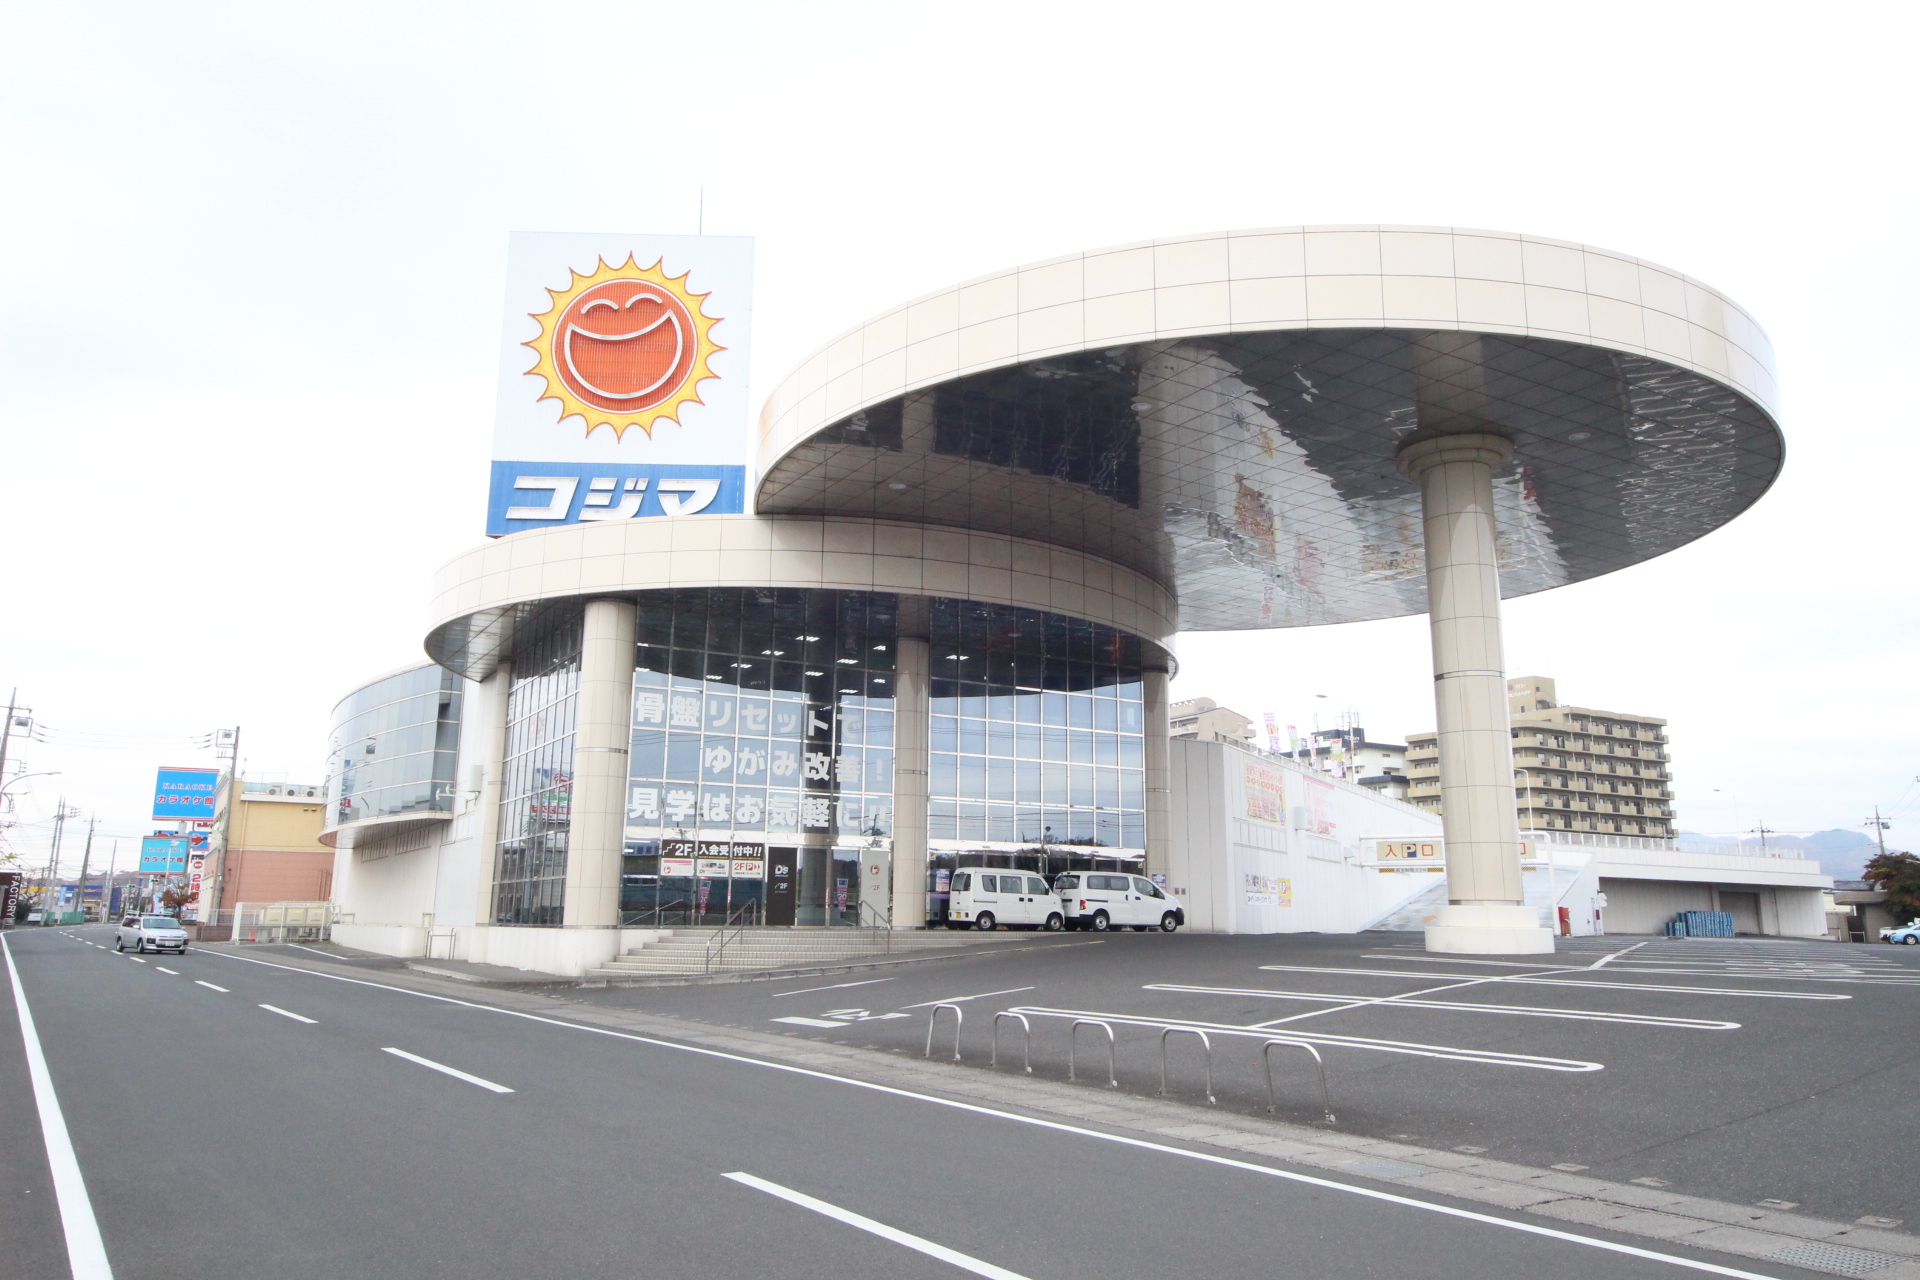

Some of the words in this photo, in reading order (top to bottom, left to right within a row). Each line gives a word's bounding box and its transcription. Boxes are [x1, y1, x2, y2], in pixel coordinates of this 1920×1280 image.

[505, 475, 722, 521] コジマ
[636, 692, 862, 738] 骨盤リセットで
[162, 782, 213, 791] KARAOKE
[156, 795, 215, 805] カラオケ館
[674, 843, 693, 856] 2F
[143, 856, 184, 864] カラオケ館
[733, 862, 745, 871] 2F
[779, 882, 788, 890] 2F
[6, 875, 21, 919] FACTORY
